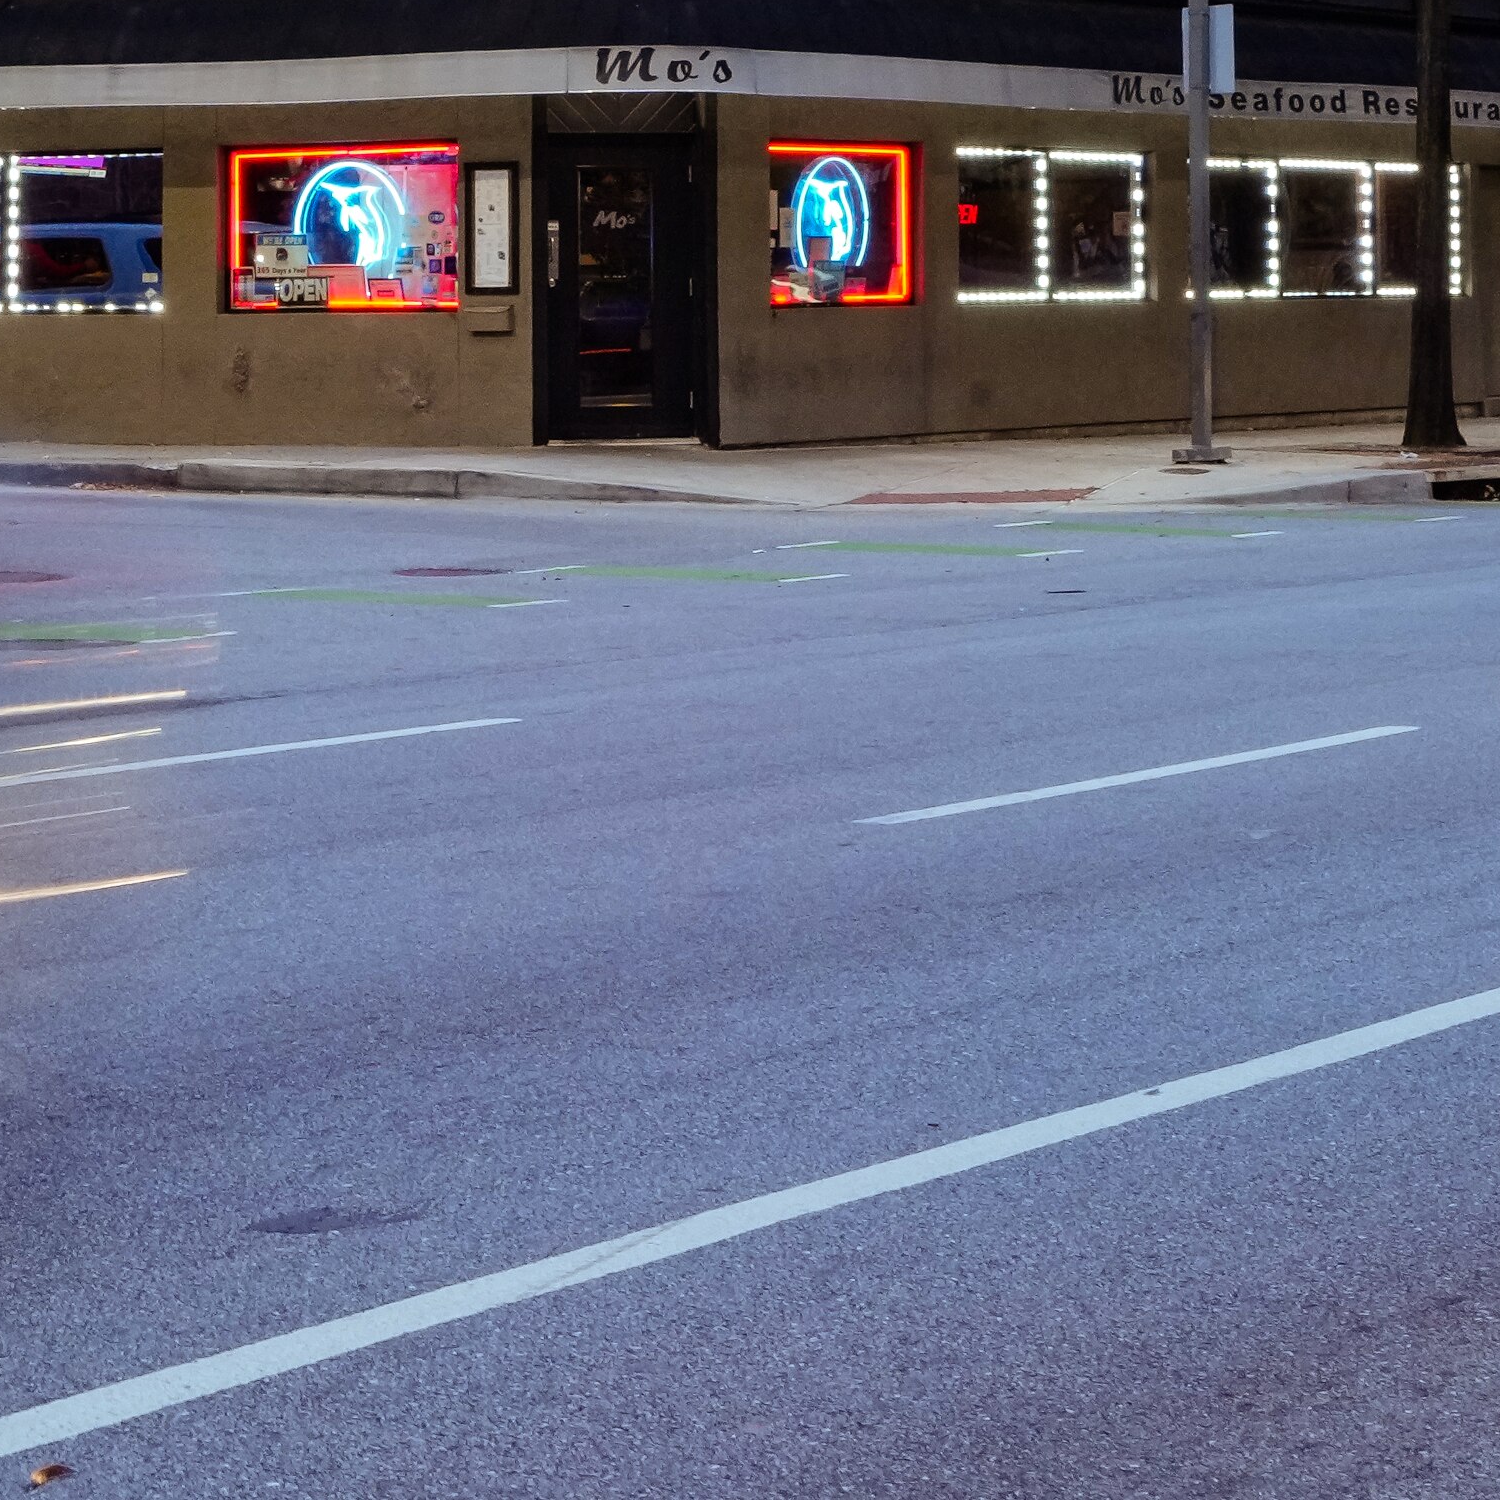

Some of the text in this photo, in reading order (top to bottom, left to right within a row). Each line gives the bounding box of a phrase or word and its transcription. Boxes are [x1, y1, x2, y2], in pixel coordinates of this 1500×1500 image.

[595, 47, 733, 84] Mo's
[1112, 75, 1185, 105] Mo's
[592, 210, 636, 229] Mo's
[257, 266, 270, 274] 365
[272, 267, 287, 276] Days
[280, 278, 328, 302] OPEN
